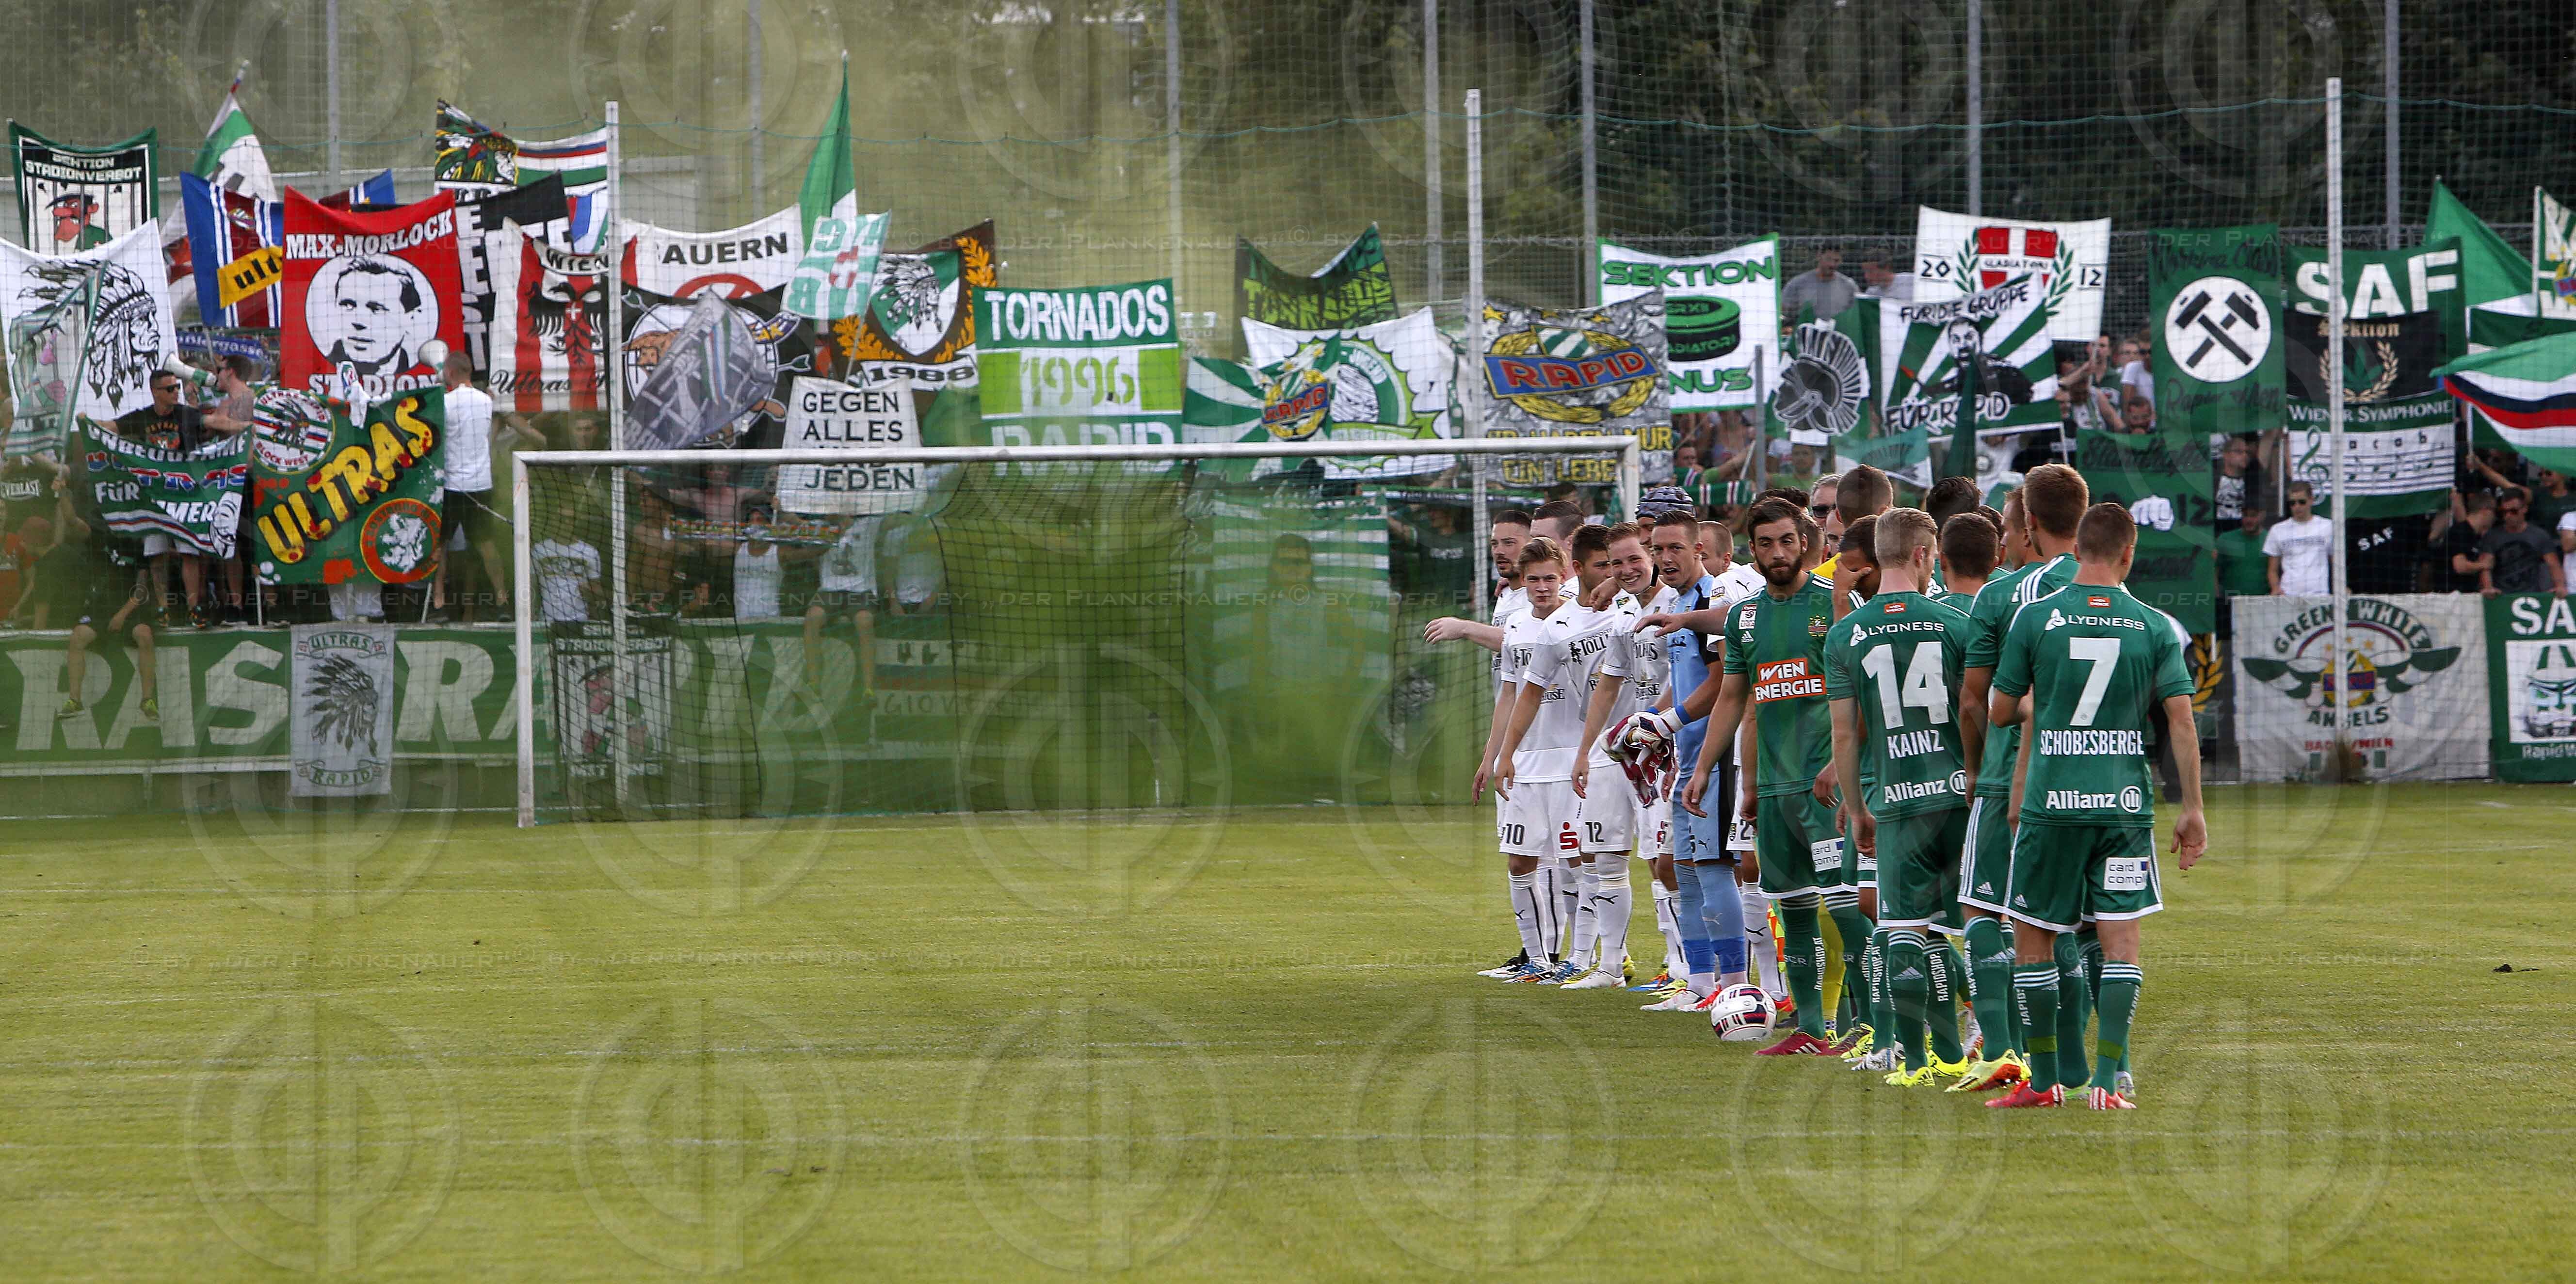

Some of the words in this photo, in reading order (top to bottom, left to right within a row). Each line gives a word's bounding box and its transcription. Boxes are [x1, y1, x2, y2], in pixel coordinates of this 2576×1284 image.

[25, 160, 143, 181] STADIONVERBOT
[285, 209, 453, 260] MAX-MORLOCK
[650, 231, 789, 266] AUERN
[1603, 257, 1773, 288] SEKTION
[1921, 259, 1950, 277] 20
[2080, 268, 2101, 287] 12
[2295, 248, 2458, 321] SAF
[984, 285, 1171, 341] TORNADOS
[1499, 349, 1646, 388] RAPID
[308, 372, 438, 394] STDION
[1021, 355, 1136, 407] 1996
[802, 391, 900, 413] GEGEN
[1264, 386, 1327, 421] RAPID
[802, 420, 903, 442] ALLES
[257, 395, 433, 565] ULTRAS
[804, 467, 916, 490] JEDEN
[1502, 458, 1545, 484] EIN
[1555, 458, 1618, 484] LEBE
[95, 481, 140, 504] FÜR
[150, 498, 218, 524] MER
[1868, 621, 1945, 635] LYONESS
[2067, 614, 2146, 630] LYONESS
[310, 634, 370, 650] ULTRAS
[1760, 660, 1806, 682] WIEN
[2069, 637, 2121, 726] 7
[1755, 678, 1823, 702] ENERGIE
[1861, 641, 1949, 730] 14
[2307, 706, 2389, 728] ANELS
[1886, 729, 1945, 760] KAINZ
[1884, 779, 1947, 804] Allianz
[2045, 790, 2117, 810] Allianz
[1504, 823, 1525, 846] 10
[1585, 821, 1605, 844] 12
[2109, 861, 2134, 873] card
